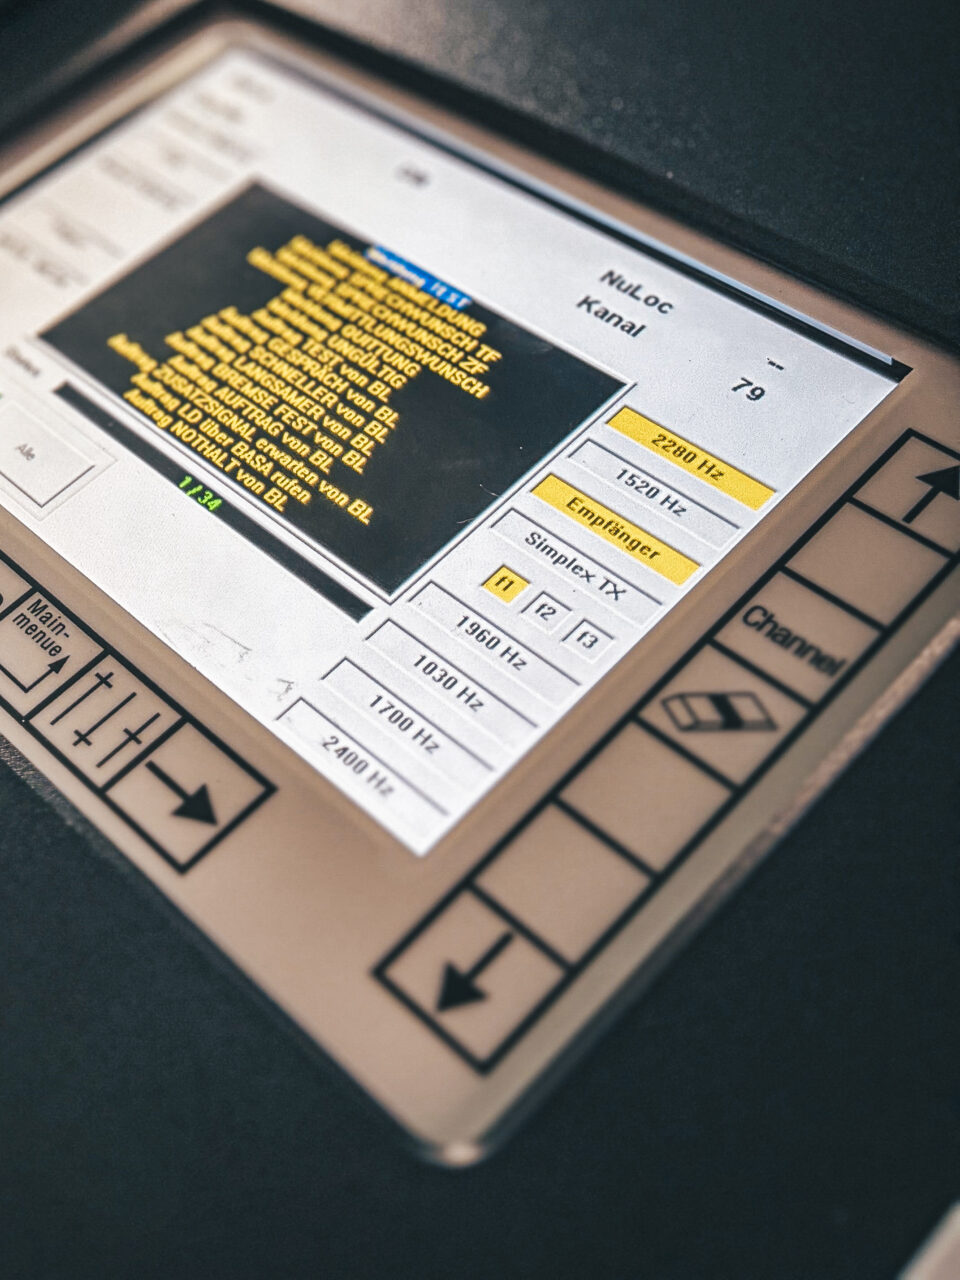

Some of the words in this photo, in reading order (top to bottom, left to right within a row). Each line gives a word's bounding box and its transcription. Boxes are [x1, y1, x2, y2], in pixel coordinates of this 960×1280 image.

[576, 295, 646, 338] Kanal
[600, 270, 674, 315] NuLoc
[301, 337, 345, 369] TEST
[339, 363, 370, 386] von
[366, 380, 392, 402] BL
[326, 333, 409, 389] UNGÜLTIG
[340, 323, 422, 378] QUITTUNG
[458, 355, 490, 375] ZF
[475, 343, 502, 363] TF
[232, 354, 326, 421] LANGSAMER
[322, 414, 353, 440] von
[349, 432, 376, 457] BL
[248, 344, 339, 408] SCHNELLER
[335, 402, 366, 428] von
[363, 419, 389, 443] BL
[267, 333, 354, 394] GESPRÄCH
[346, 387, 377, 413] von
[373, 405, 399, 429] BL
[731, 377, 766, 401] 79
[150, 363, 257, 443] ZUSATZSIGNAL
[255, 437, 320, 486] erwarten
[318, 479, 350, 508] von
[346, 498, 374, 525] BL
[211, 361, 279, 410] BREMSE
[272, 403, 319, 436] FEST
[313, 430, 344, 457] von
[341, 449, 368, 474] BL
[213, 386, 285, 437] AUFTRAG
[281, 431, 312, 457] von
[308, 448, 334, 474] BL
[15, 444, 36, 461] Alle
[169, 419, 242, 473] NOTHALT
[235, 467, 266, 495] von
[263, 487, 289, 512] BL
[176, 402, 204, 424] LD
[198, 417, 235, 447] über
[230, 440, 274, 477] BASA
[269, 470, 312, 505] rufen
[651, 433, 697, 464] 2280
[698, 459, 725, 481] Hz
[616, 468, 660, 499] 1520
[660, 495, 687, 517] Hz
[565, 497, 661, 560] Empfänger
[494, 576, 514, 592] f1
[525, 532, 595, 583] Simplex
[598, 578, 627, 602] TX
[12, 613, 62, 657] menue
[27, 599, 69, 639] Main-
[535, 603, 557, 621] f2
[576, 631, 599, 649] f3
[456, 615, 501, 650] 1960
[500, 646, 528, 671] Hz
[742, 605, 846, 677] Channel
[413, 654, 458, 690] 1030
[457, 686, 484, 712] Hz
[369, 695, 414, 732] 1700
[412, 728, 440, 754] Hz
[322, 735, 369, 774] 2400
[367, 771, 395, 797] Hz
